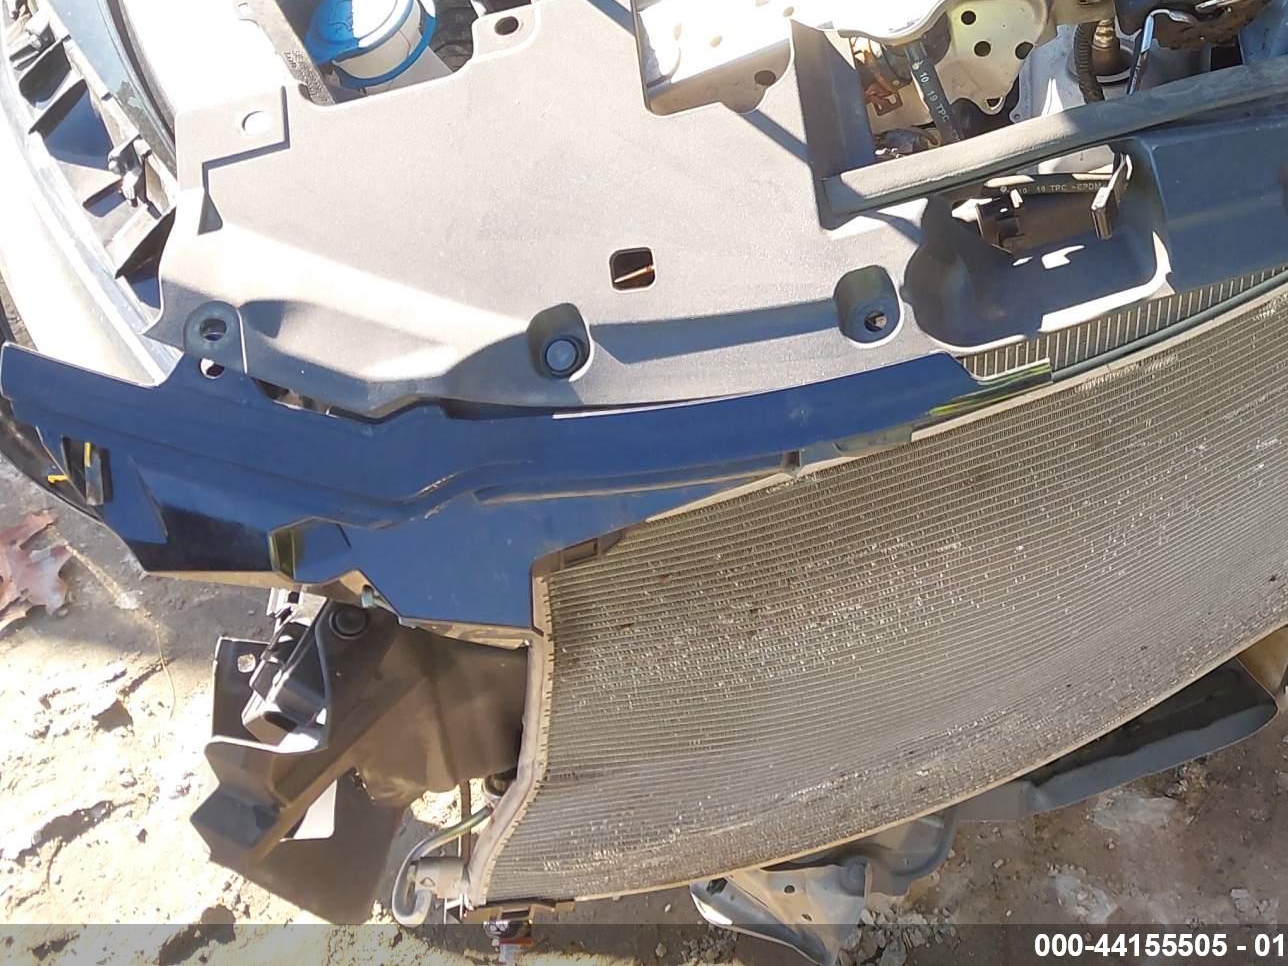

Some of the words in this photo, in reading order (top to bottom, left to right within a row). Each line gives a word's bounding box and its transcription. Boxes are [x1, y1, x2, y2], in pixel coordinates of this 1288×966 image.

[920, 72, 930, 83] 10
[936, 104, 950, 123] TPC
[1051, 184, 1066, 192] TPC
